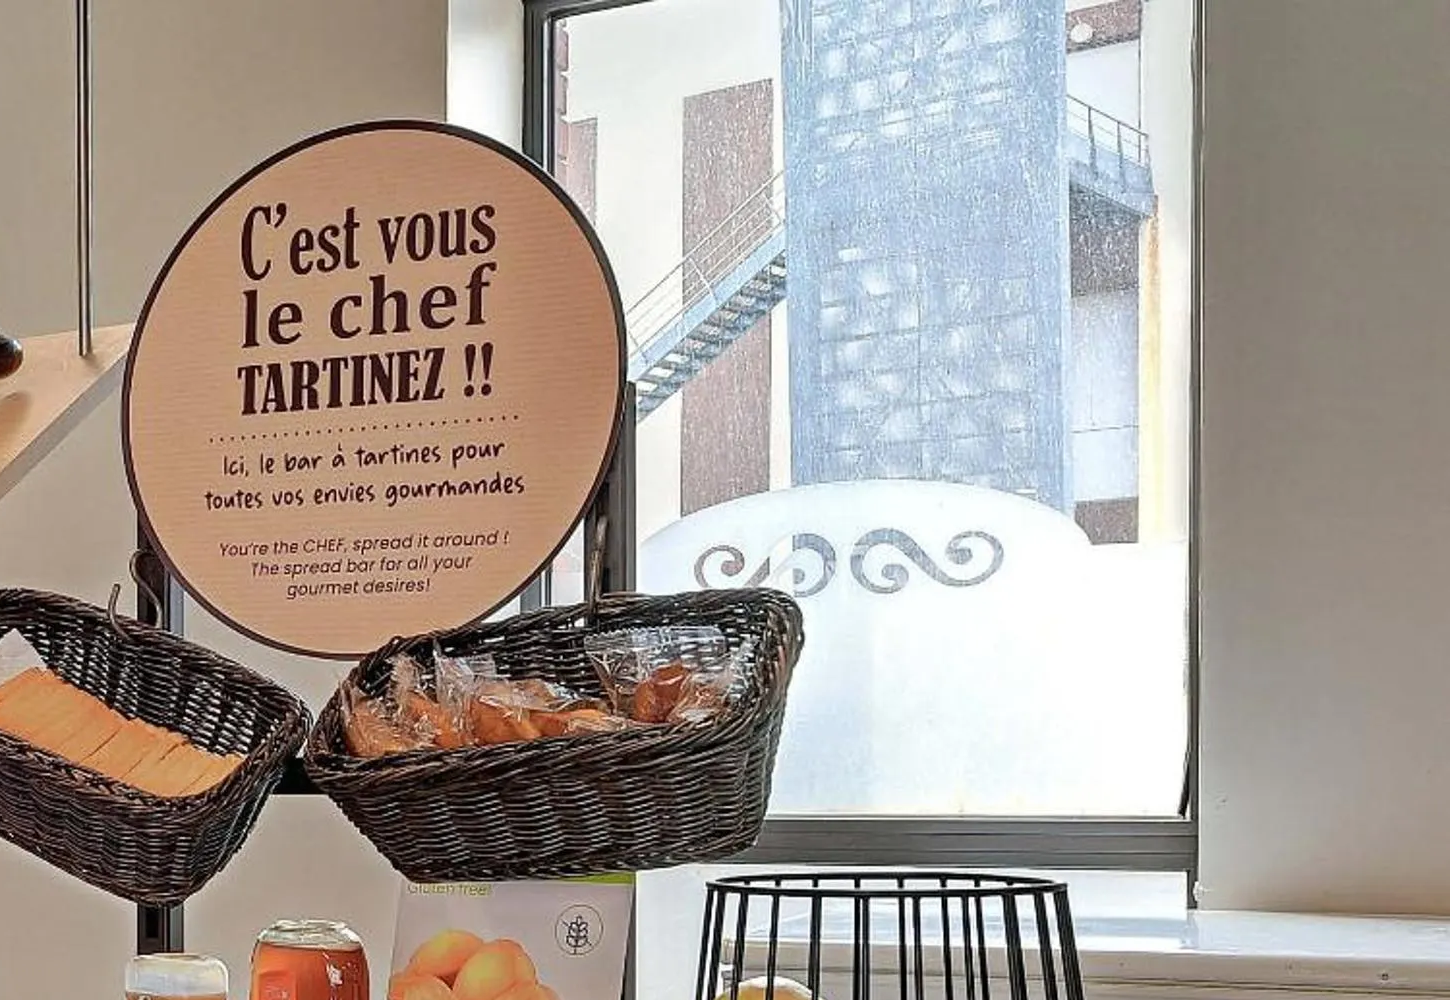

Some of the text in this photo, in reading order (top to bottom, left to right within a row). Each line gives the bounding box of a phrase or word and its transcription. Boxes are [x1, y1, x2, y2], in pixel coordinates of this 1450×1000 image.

[377, 203, 496, 264] vous
[240, 262, 497, 348] le chef
[237, 342, 494, 416] TARTINEZ !!
[222, 440, 505, 478] Ici, le bar à tartines pour
[204, 471, 525, 511] toutes vos envies gourmandes
[273, 539, 299, 555] the
[302, 537, 348, 554] CHEF,
[352, 532, 414, 553] spread
[416, 532, 430, 549] it
[433, 530, 498, 549] around
[251, 556, 472, 579] The spread bar for all your
[286, 577, 431, 600] gourmet desires!
